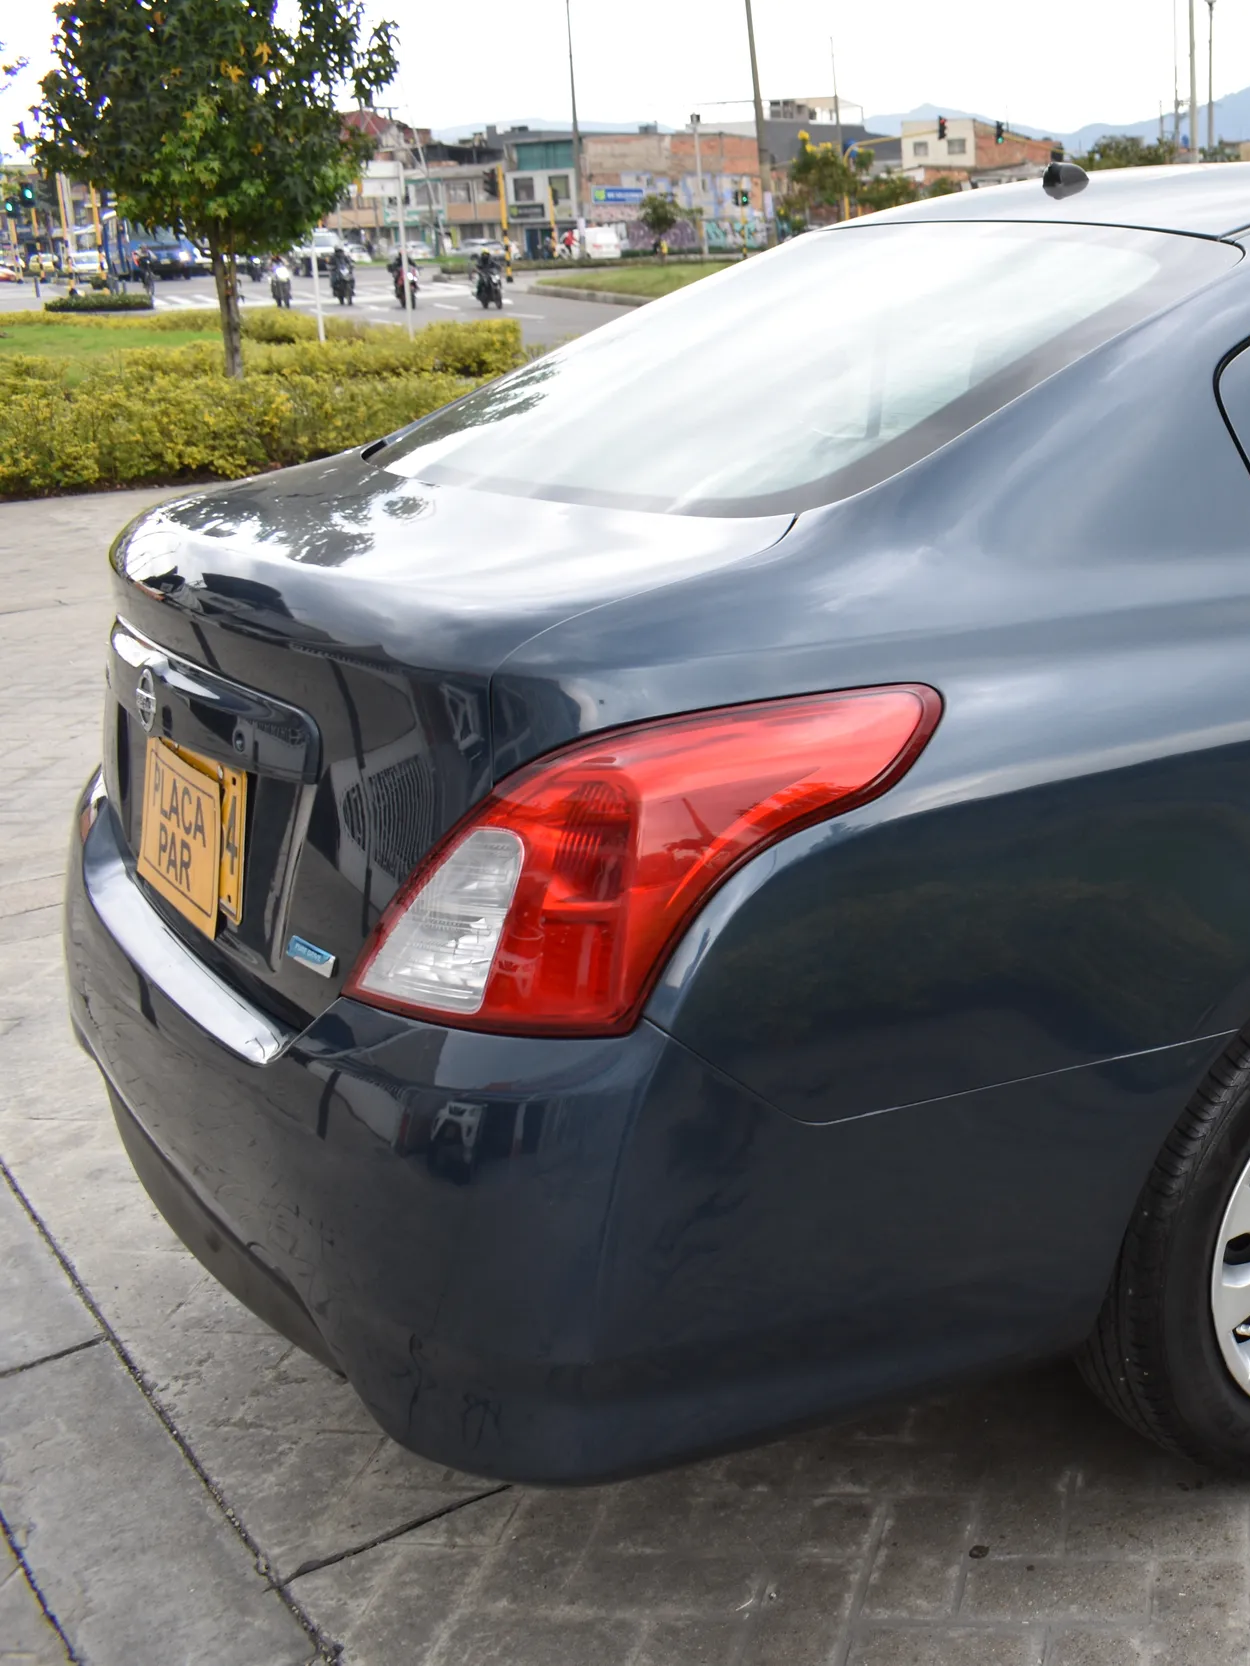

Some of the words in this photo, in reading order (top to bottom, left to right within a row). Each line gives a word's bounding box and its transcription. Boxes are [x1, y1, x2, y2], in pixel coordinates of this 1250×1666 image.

[153, 760, 206, 848] PLACA
[221, 795, 238, 876] 4
[158, 821, 192, 892] PAR
